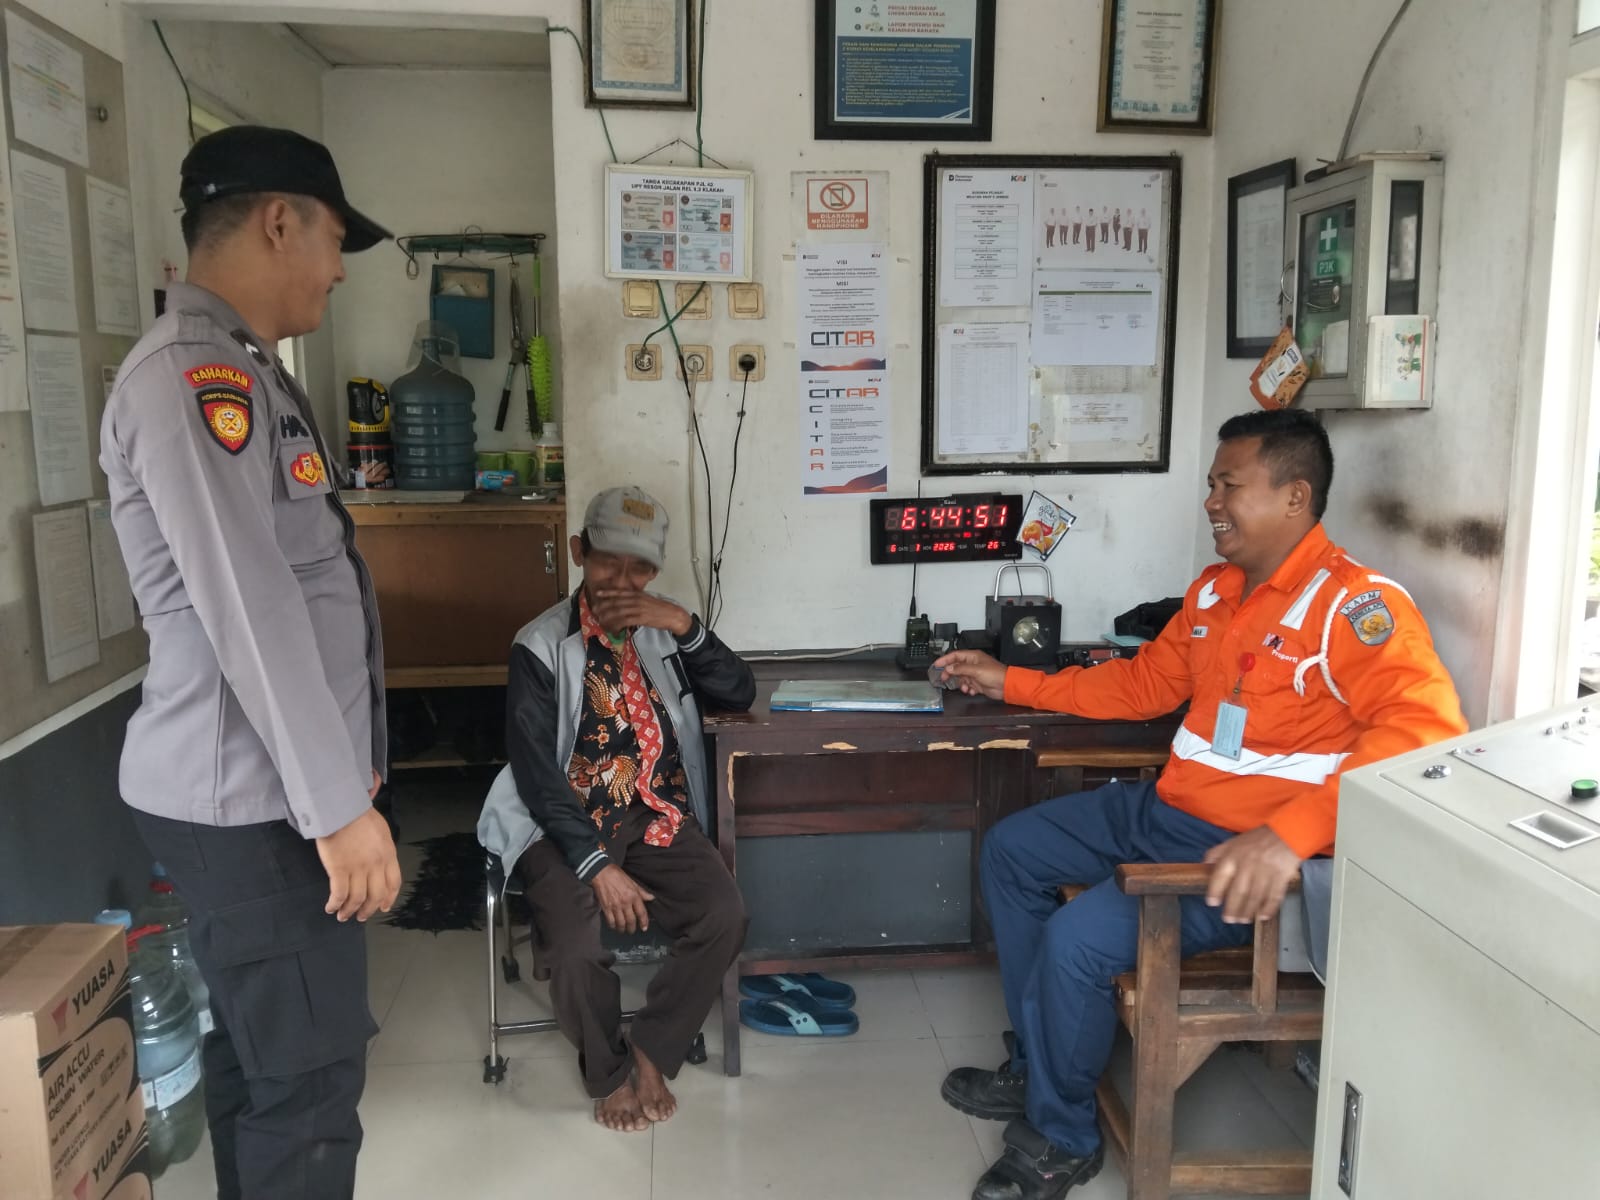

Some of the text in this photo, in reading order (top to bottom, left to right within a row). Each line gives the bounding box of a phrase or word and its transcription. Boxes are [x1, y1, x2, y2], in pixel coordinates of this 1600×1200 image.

[1320, 261, 1334, 273] P3K
[810, 331, 875, 346] CITAR
[192, 368, 248, 388] BAHARKAN
[809, 388, 879, 398] CITAR
[902, 505, 1008, 530] 6:44:51
[890, 544, 897, 552] 6
[933, 542, 956, 551] 2026
[987, 541, 999, 549] 26
[1344, 592, 1376, 610] KAPM
[1271, 649, 1299, 663] Properti
[72, 960, 115, 1015] YUASA
[48, 1042, 90, 1106] AIR ACCU
[49, 1048, 104, 1121] DEMIN WATER
[92, 1118, 132, 1183] YUASA
